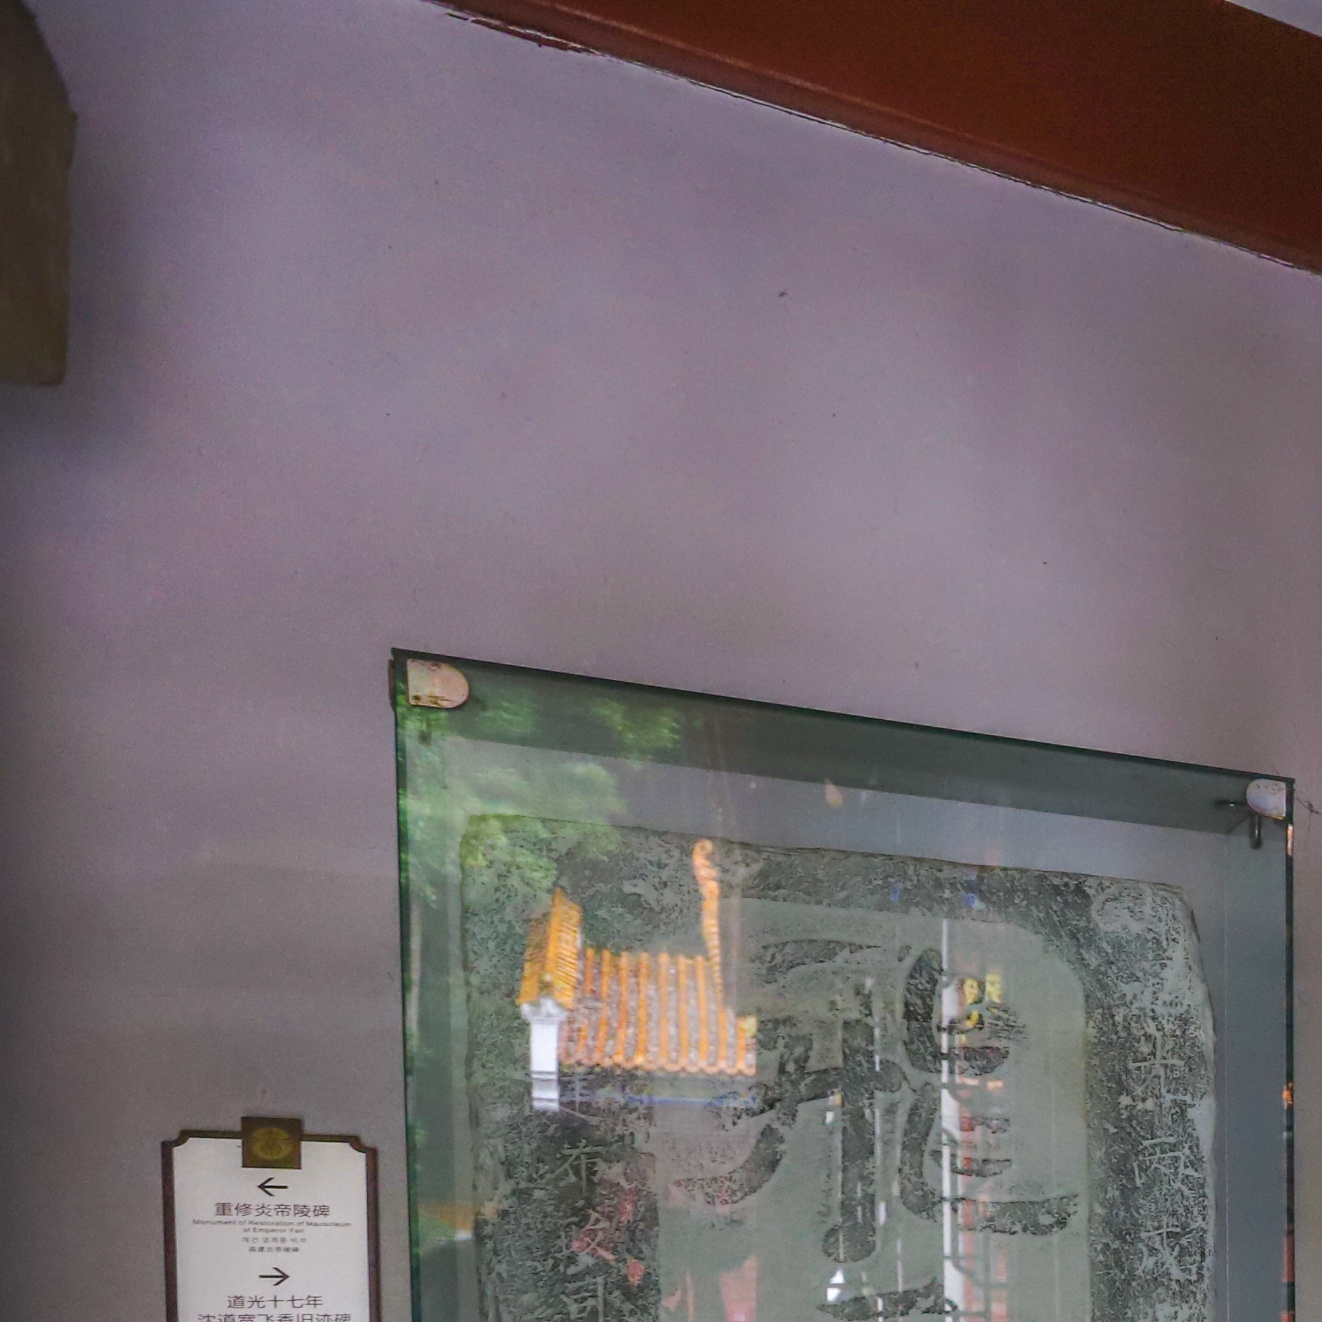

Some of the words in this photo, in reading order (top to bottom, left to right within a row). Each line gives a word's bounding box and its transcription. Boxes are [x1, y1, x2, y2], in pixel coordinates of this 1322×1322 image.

[214, 1202, 331, 1218] 重修炎帝陵碑
[192, 1218, 236, 1226] Monument
[227, 1295, 323, 1309] 道光十七年
